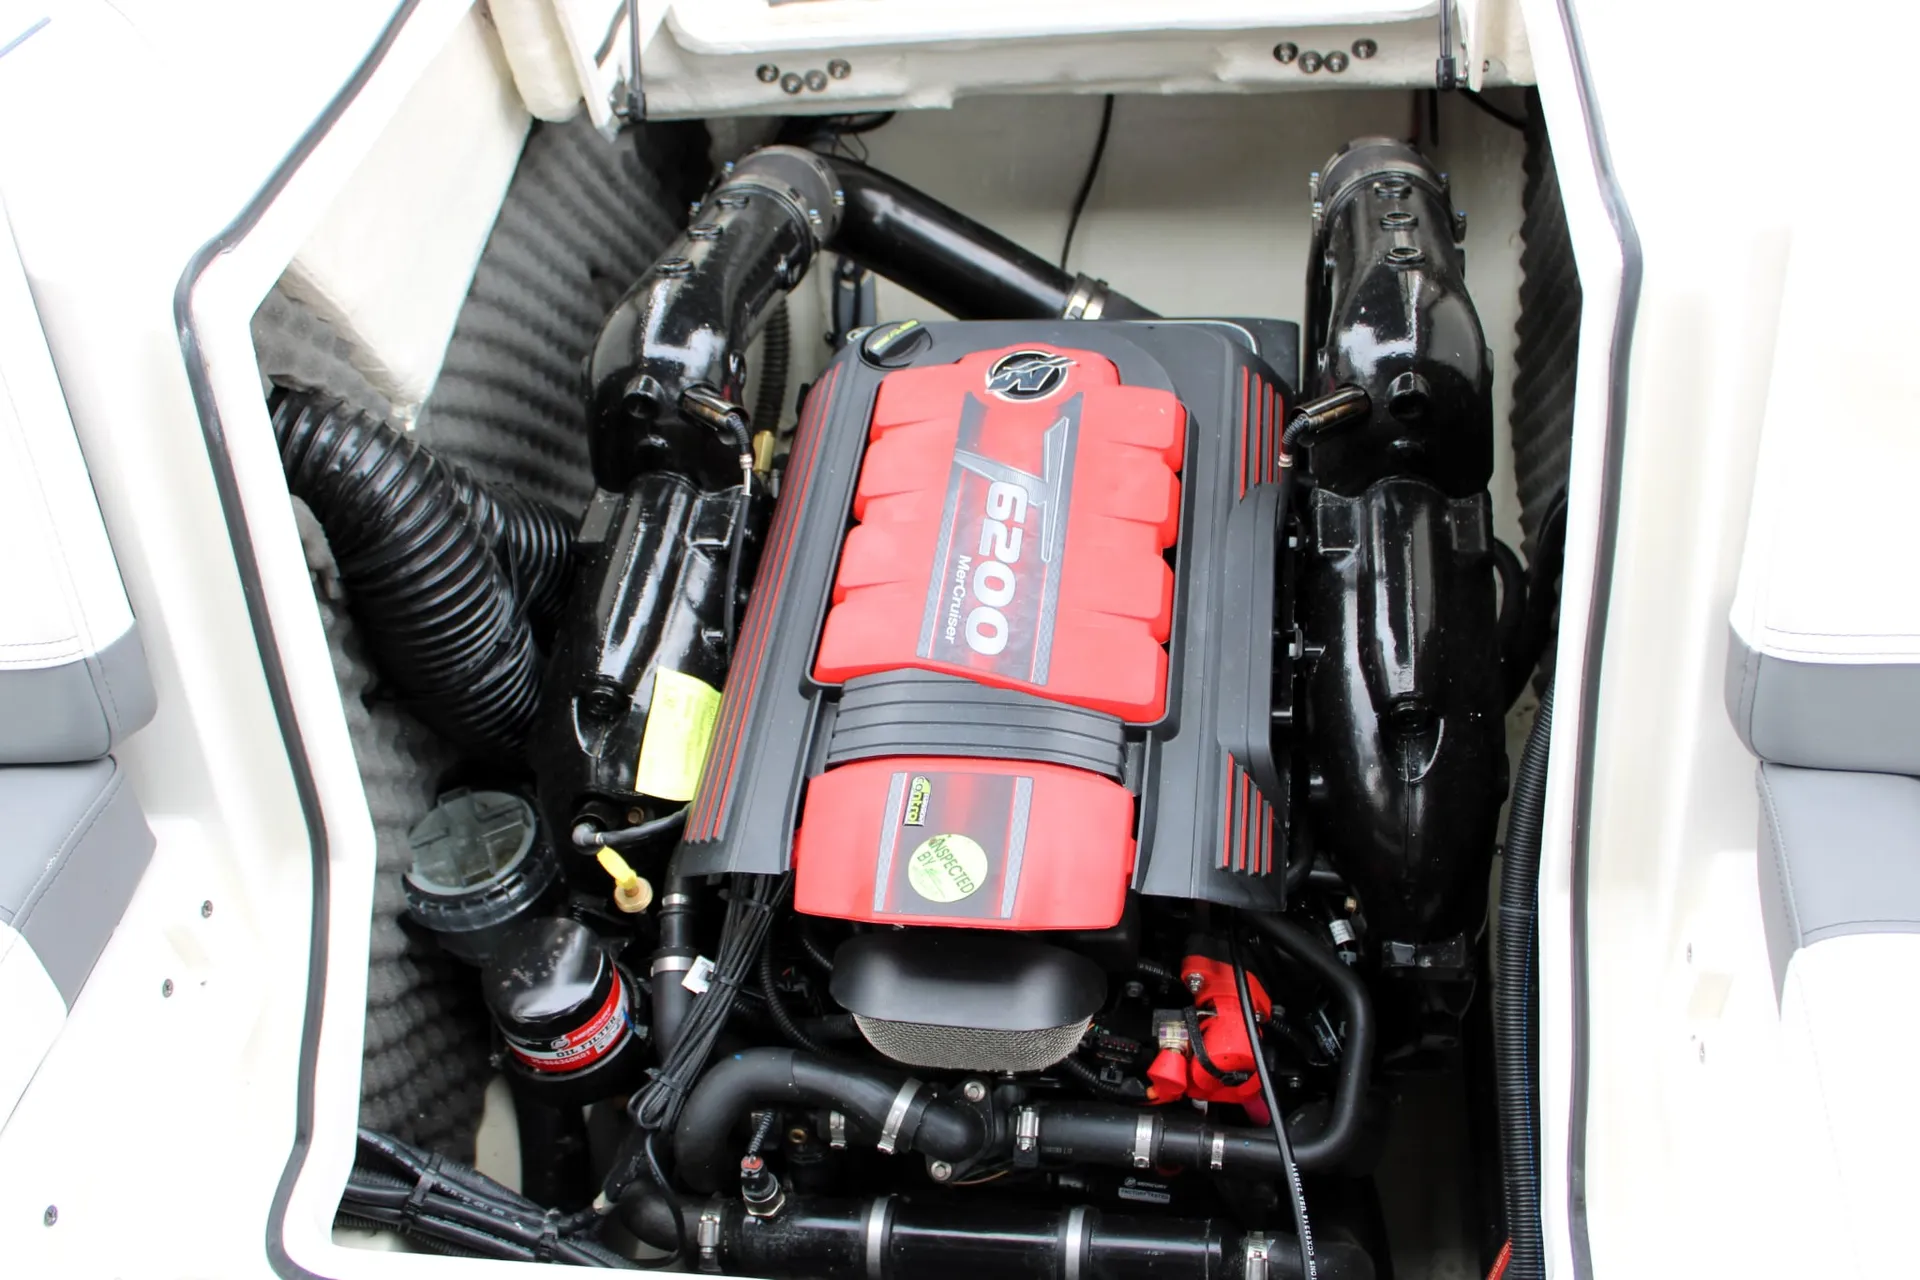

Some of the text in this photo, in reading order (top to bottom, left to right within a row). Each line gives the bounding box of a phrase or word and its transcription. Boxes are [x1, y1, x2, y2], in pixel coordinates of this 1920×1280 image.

[965, 480, 1029, 656] 6200
[945, 554, 972, 644] MerCruiser
[917, 851, 936, 867] BY
[556, 1015, 616, 1058] OIL FILTER
[1299, 1196, 1307, 1212] USA
